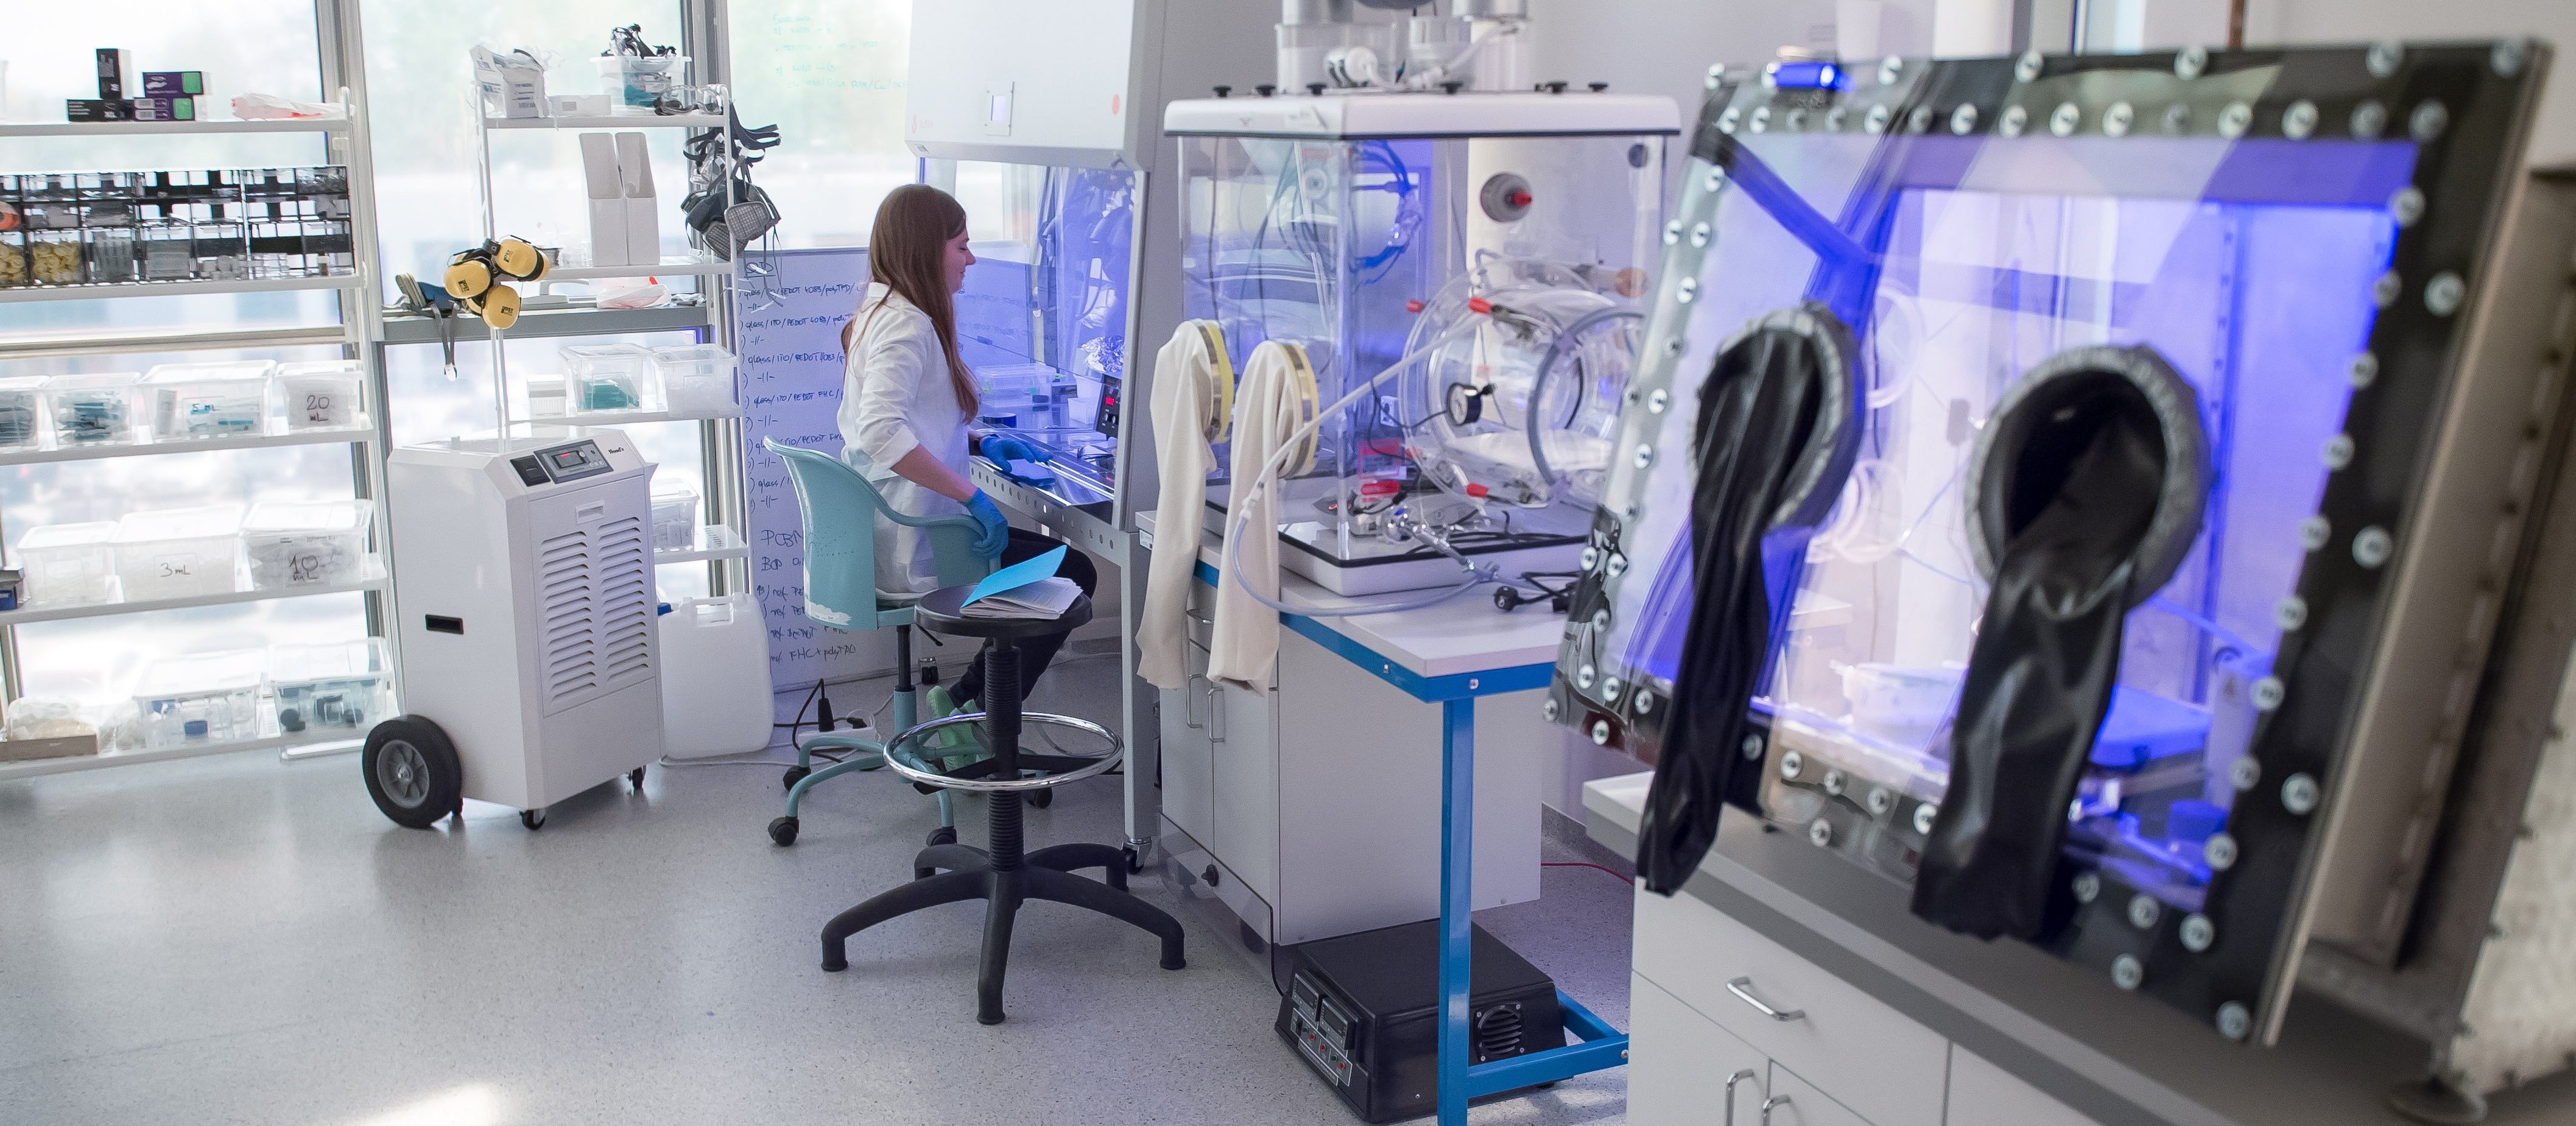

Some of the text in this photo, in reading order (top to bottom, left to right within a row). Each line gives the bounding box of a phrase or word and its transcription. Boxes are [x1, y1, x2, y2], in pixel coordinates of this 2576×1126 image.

[306, 394, 330, 410] 20
[310, 412, 329, 421] mL
[160, 563, 173, 577] 3
